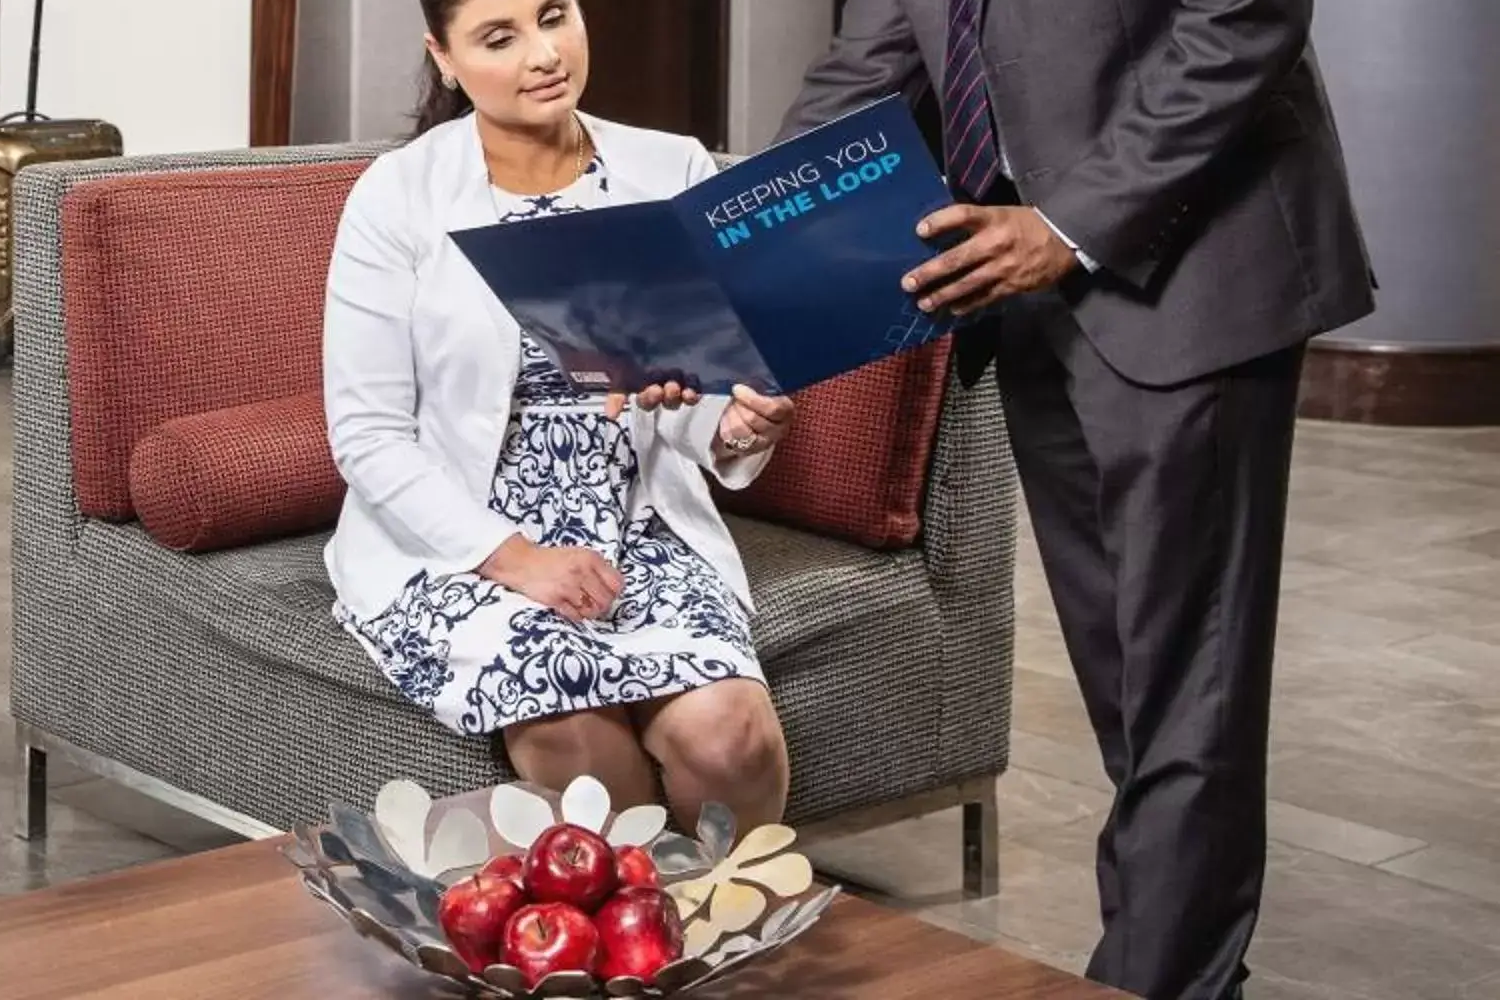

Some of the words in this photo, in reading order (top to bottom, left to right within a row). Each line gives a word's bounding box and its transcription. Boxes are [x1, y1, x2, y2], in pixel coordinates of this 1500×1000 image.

[704, 163, 821, 229] KEEPING
[825, 131, 888, 169] YOU
[716, 220, 751, 249] IN
[754, 191, 817, 229] THE
[819, 152, 901, 201] LOOP
